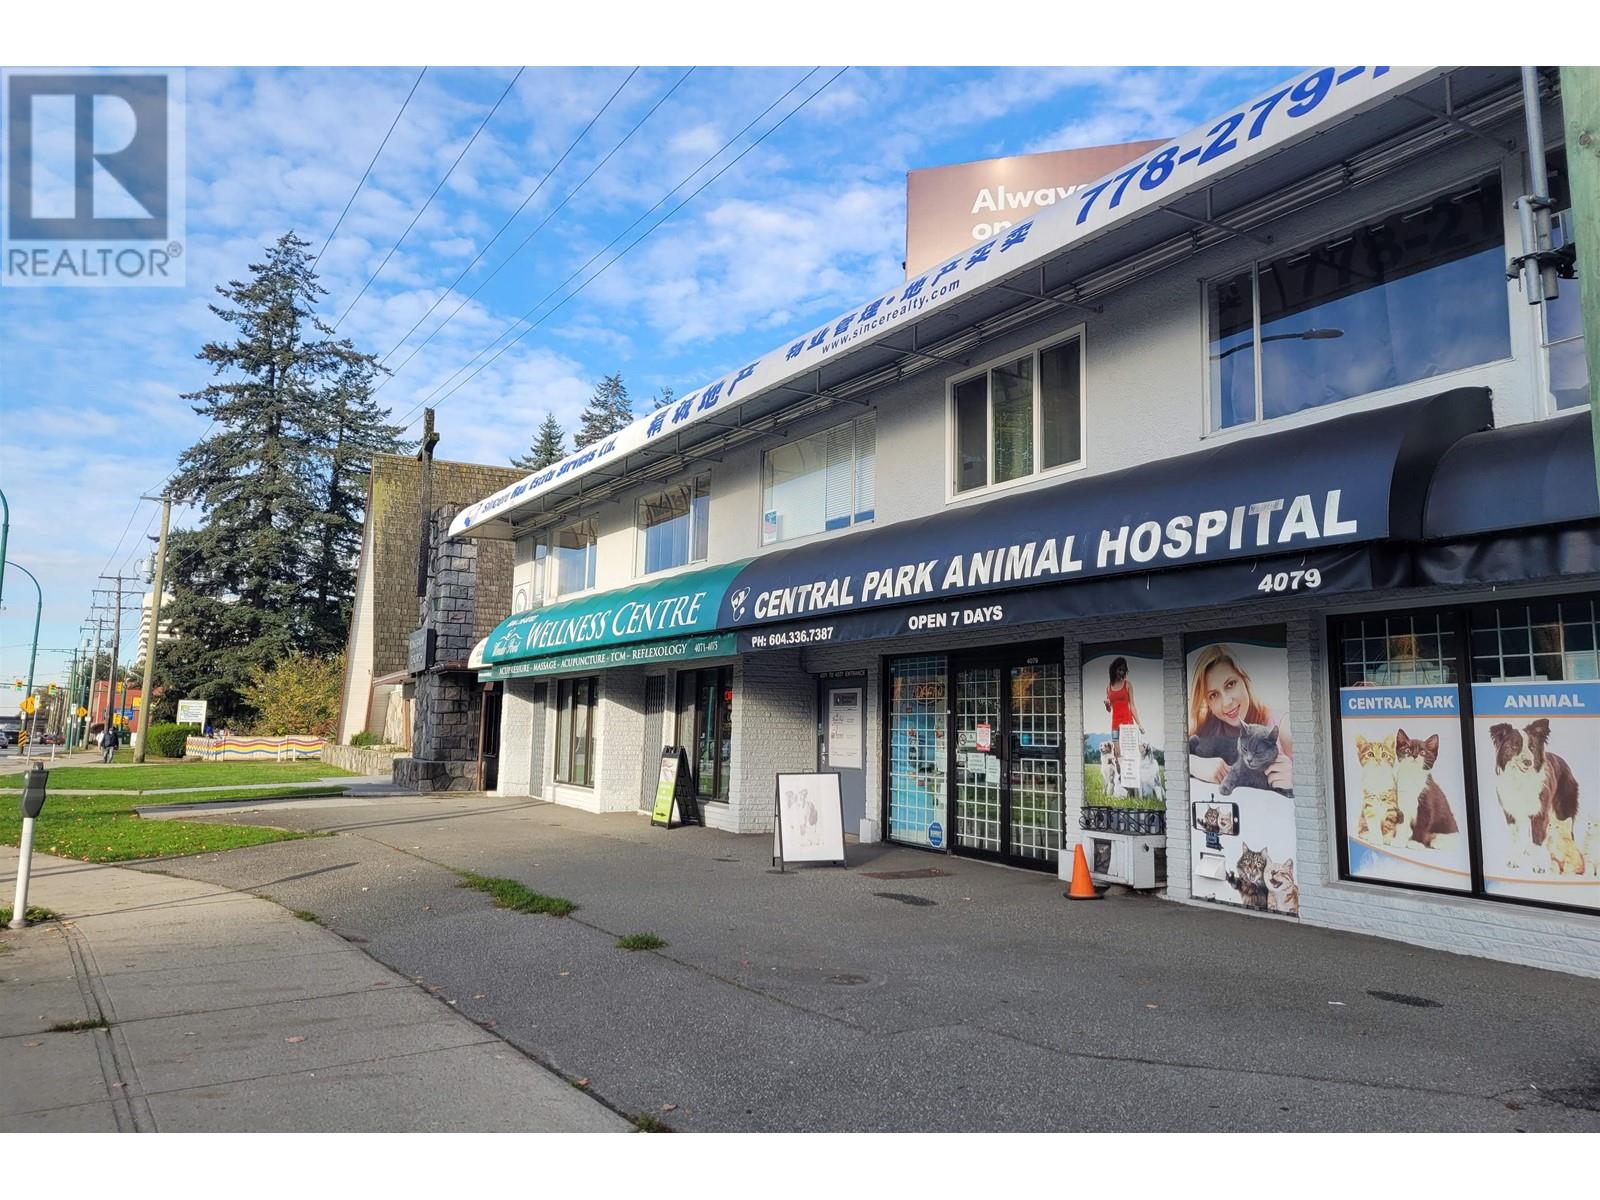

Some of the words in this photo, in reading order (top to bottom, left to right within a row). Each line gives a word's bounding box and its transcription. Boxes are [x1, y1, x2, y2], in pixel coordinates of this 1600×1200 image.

[1075, 67, 1391, 226] 778-279-
[821, 278, 960, 354] www.sincerealty.com
[556, 449, 598, 478] Services
[754, 576, 854, 620] CENTRAL
[861, 560, 939, 602] PARK
[942, 535, 1083, 591] ANIMAL
[1096, 489, 1358, 568] HOSPITAL
[1257, 568, 1322, 593] 4079
[525, 609, 612, 650] WELLNESS
[611, 592, 708, 637] CENTRE
[908, 611, 947, 630] OPEN
[951, 611, 959, 626] 7
[963, 605, 1003, 625] DAYS
[751, 635, 767, 648] PH:
[769, 626, 834, 647] 604.336.7387
[533, 660, 557, 671] MASSAGE
[560, 653, 606, 668] ACUPUNCTURE
[610, 652, 626, 662] TCM
[632, 643, 688, 659] REFLEXOLOGY
[1348, 696, 1411, 710] CENTRAL
[1415, 695, 1455, 709] PARK
[1504, 694, 1585, 708] ANIMAL
